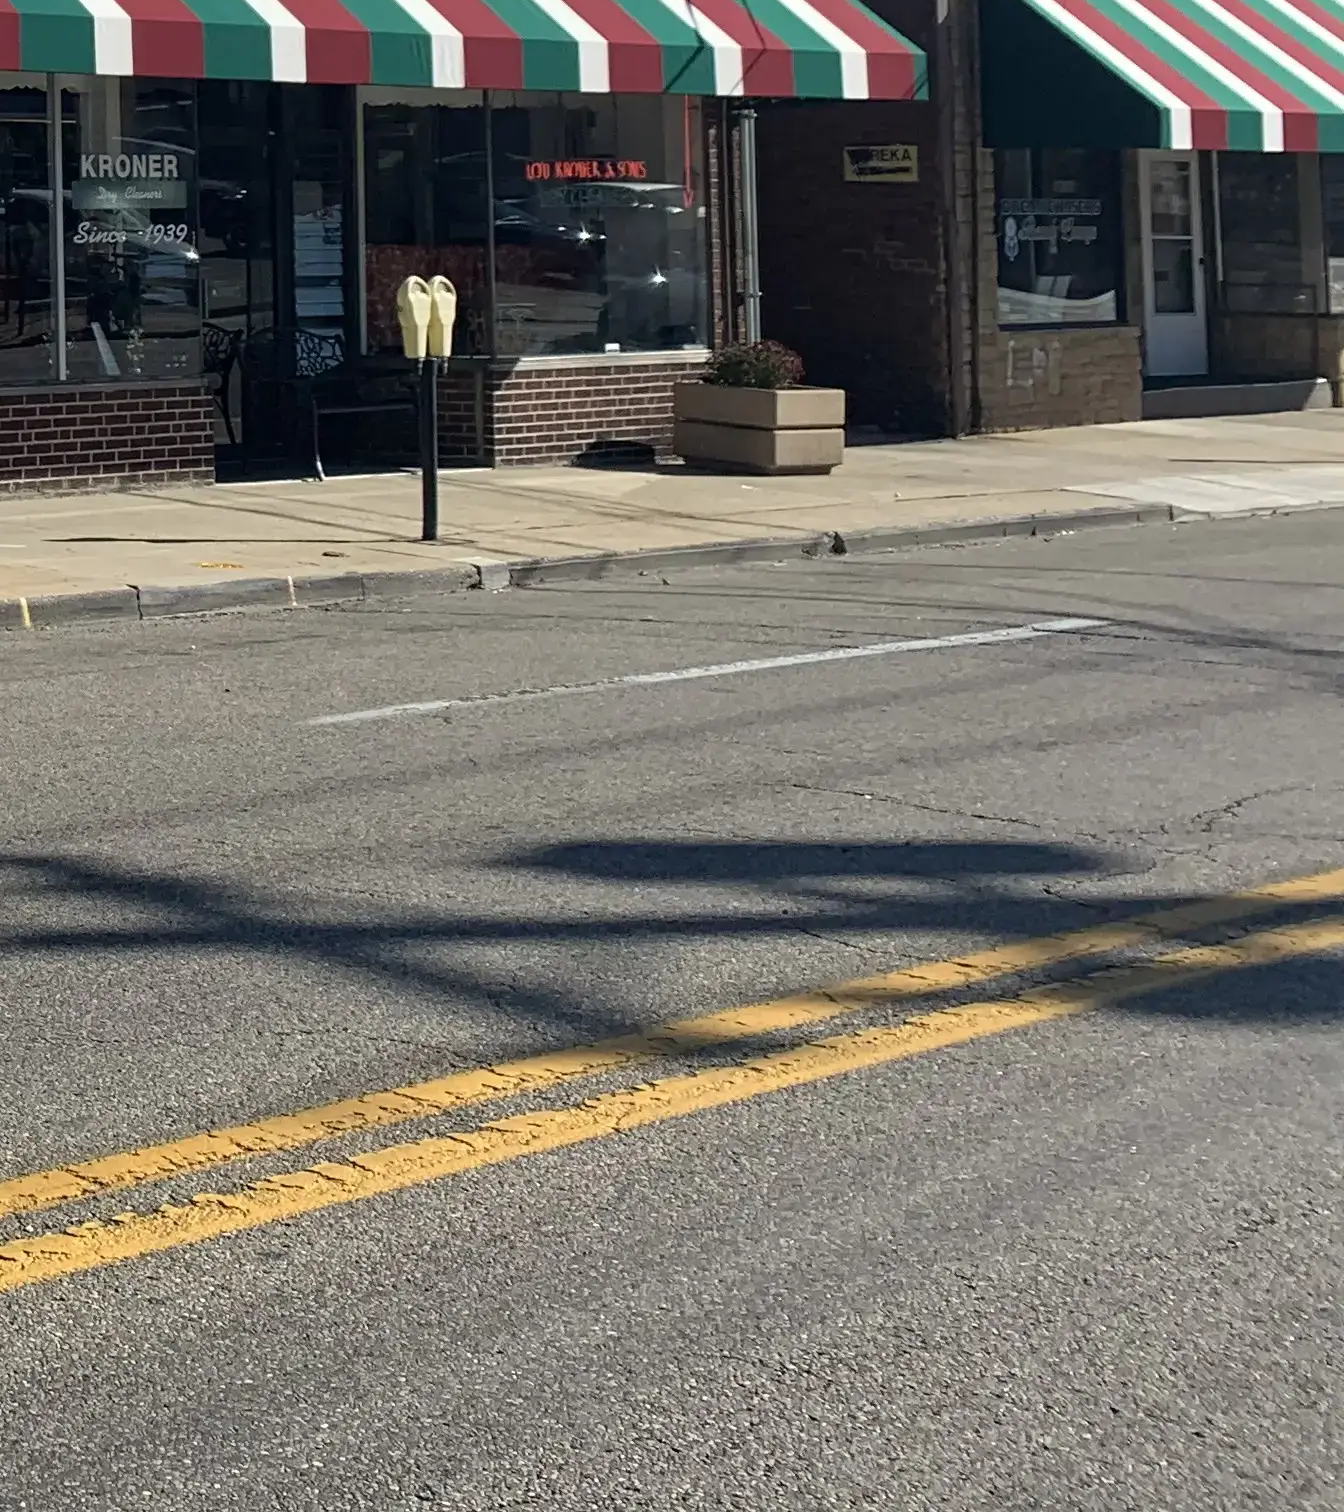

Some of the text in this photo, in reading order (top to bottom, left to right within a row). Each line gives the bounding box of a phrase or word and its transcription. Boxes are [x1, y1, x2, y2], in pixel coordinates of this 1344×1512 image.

[81, 153, 179, 178] KRONER
[96, 186, 164, 204] Dry Cleaners
[73, 221, 189, 245] Since 1939
